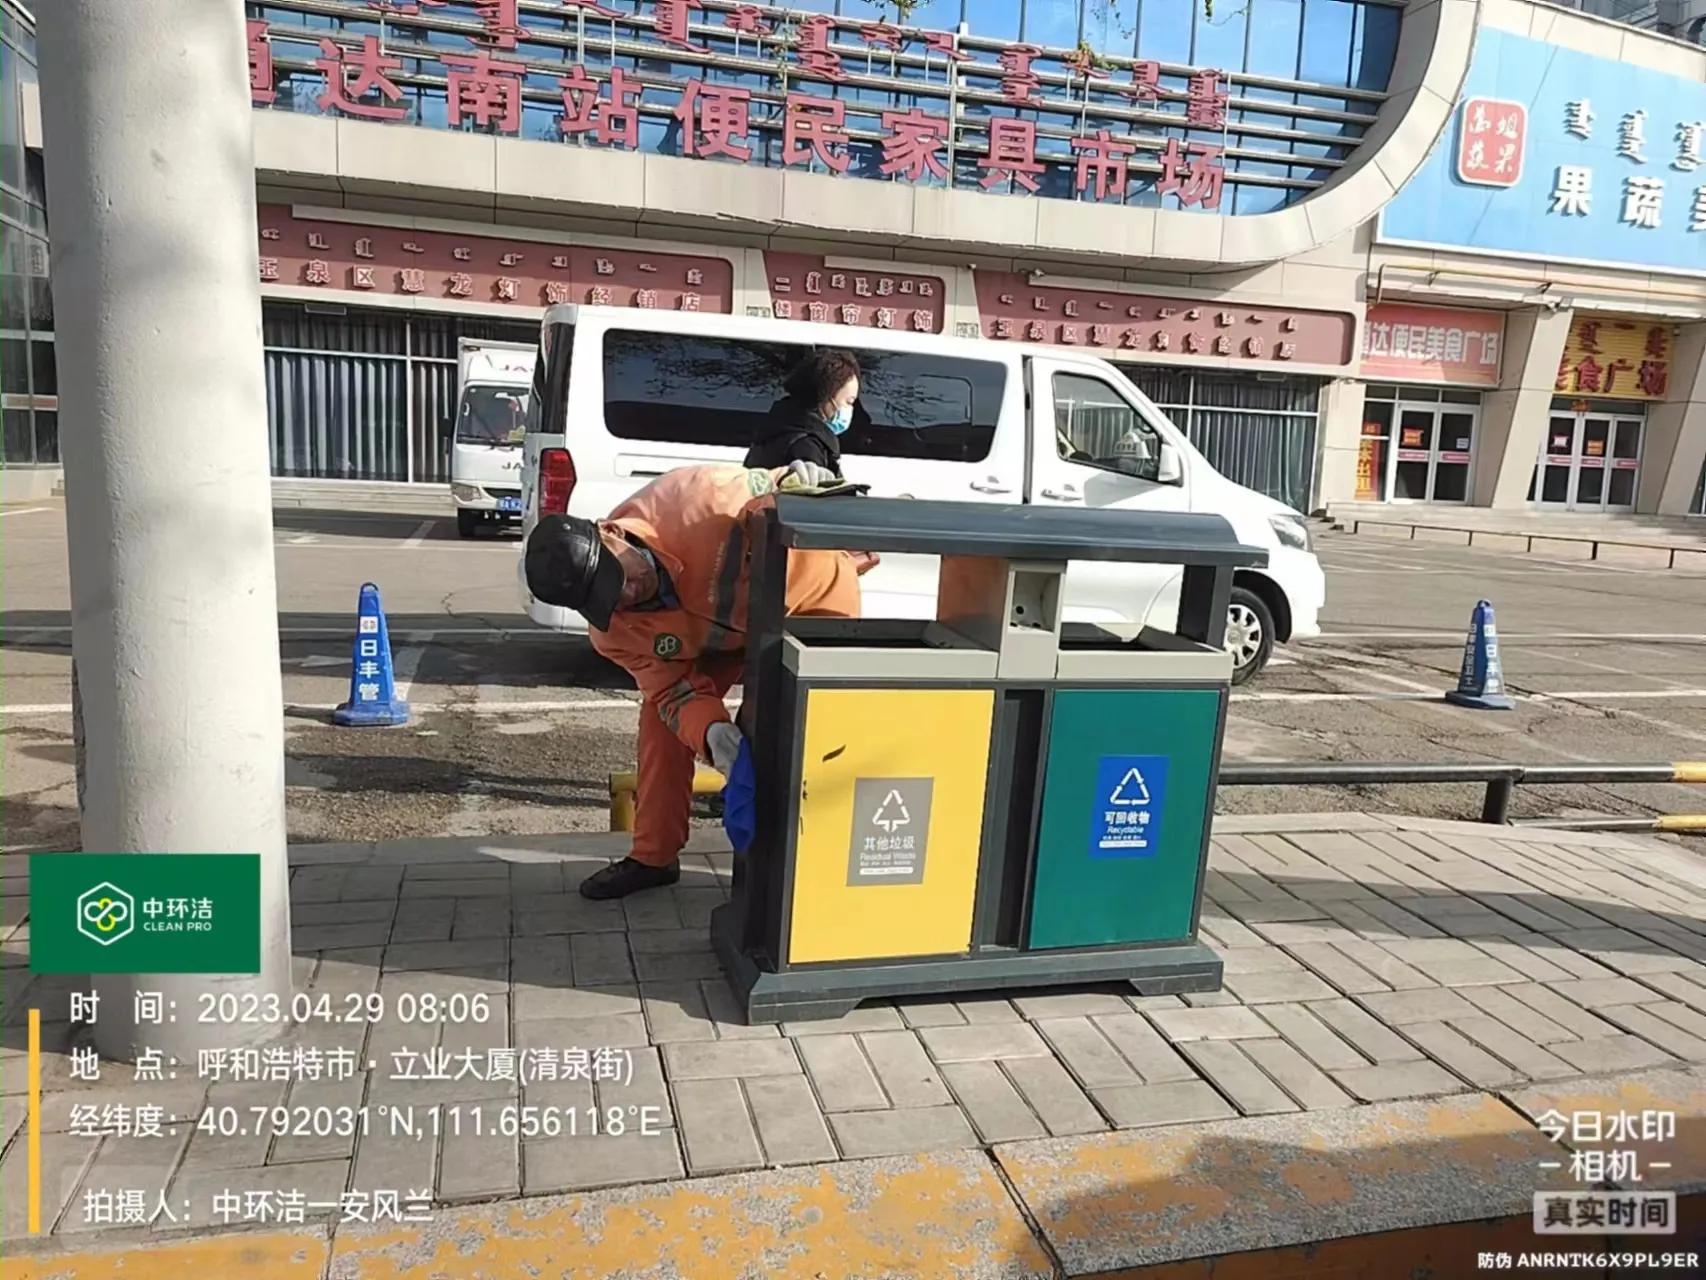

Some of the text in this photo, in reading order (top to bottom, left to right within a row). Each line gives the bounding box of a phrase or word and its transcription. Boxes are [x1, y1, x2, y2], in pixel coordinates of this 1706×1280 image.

[1104, 810, 1150, 825] 可回收物
[863, 835, 915, 851] 其他垃圾
